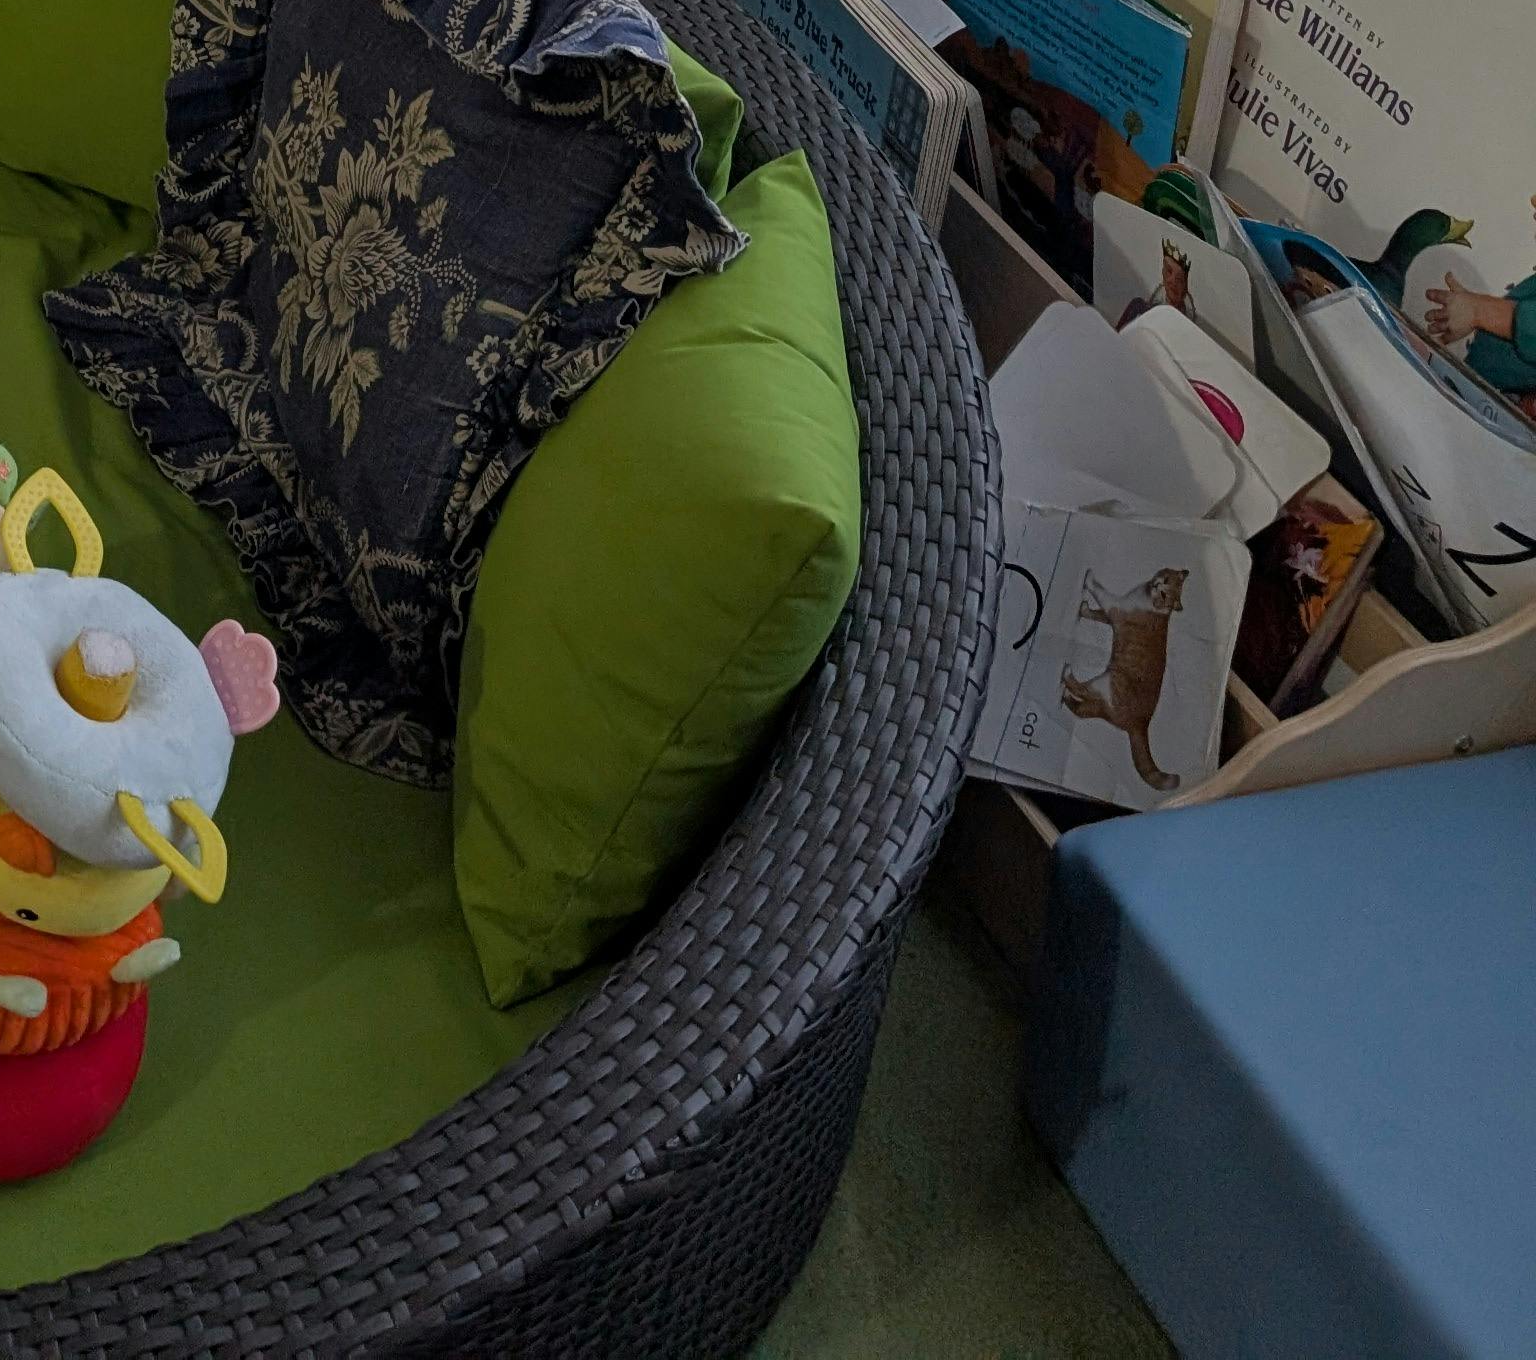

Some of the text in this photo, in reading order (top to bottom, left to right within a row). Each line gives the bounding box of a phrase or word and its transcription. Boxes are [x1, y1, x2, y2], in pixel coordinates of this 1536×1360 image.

[830, 33, 880, 117] Truck
[1297, 5, 1417, 128] Williams
[1366, 29, 1385, 50] BY
[1242, 52, 1353, 155] ILLUSTRATED BY
[1280, 115, 1351, 205] Vivas
[1020, 711, 1041, 751] cat
